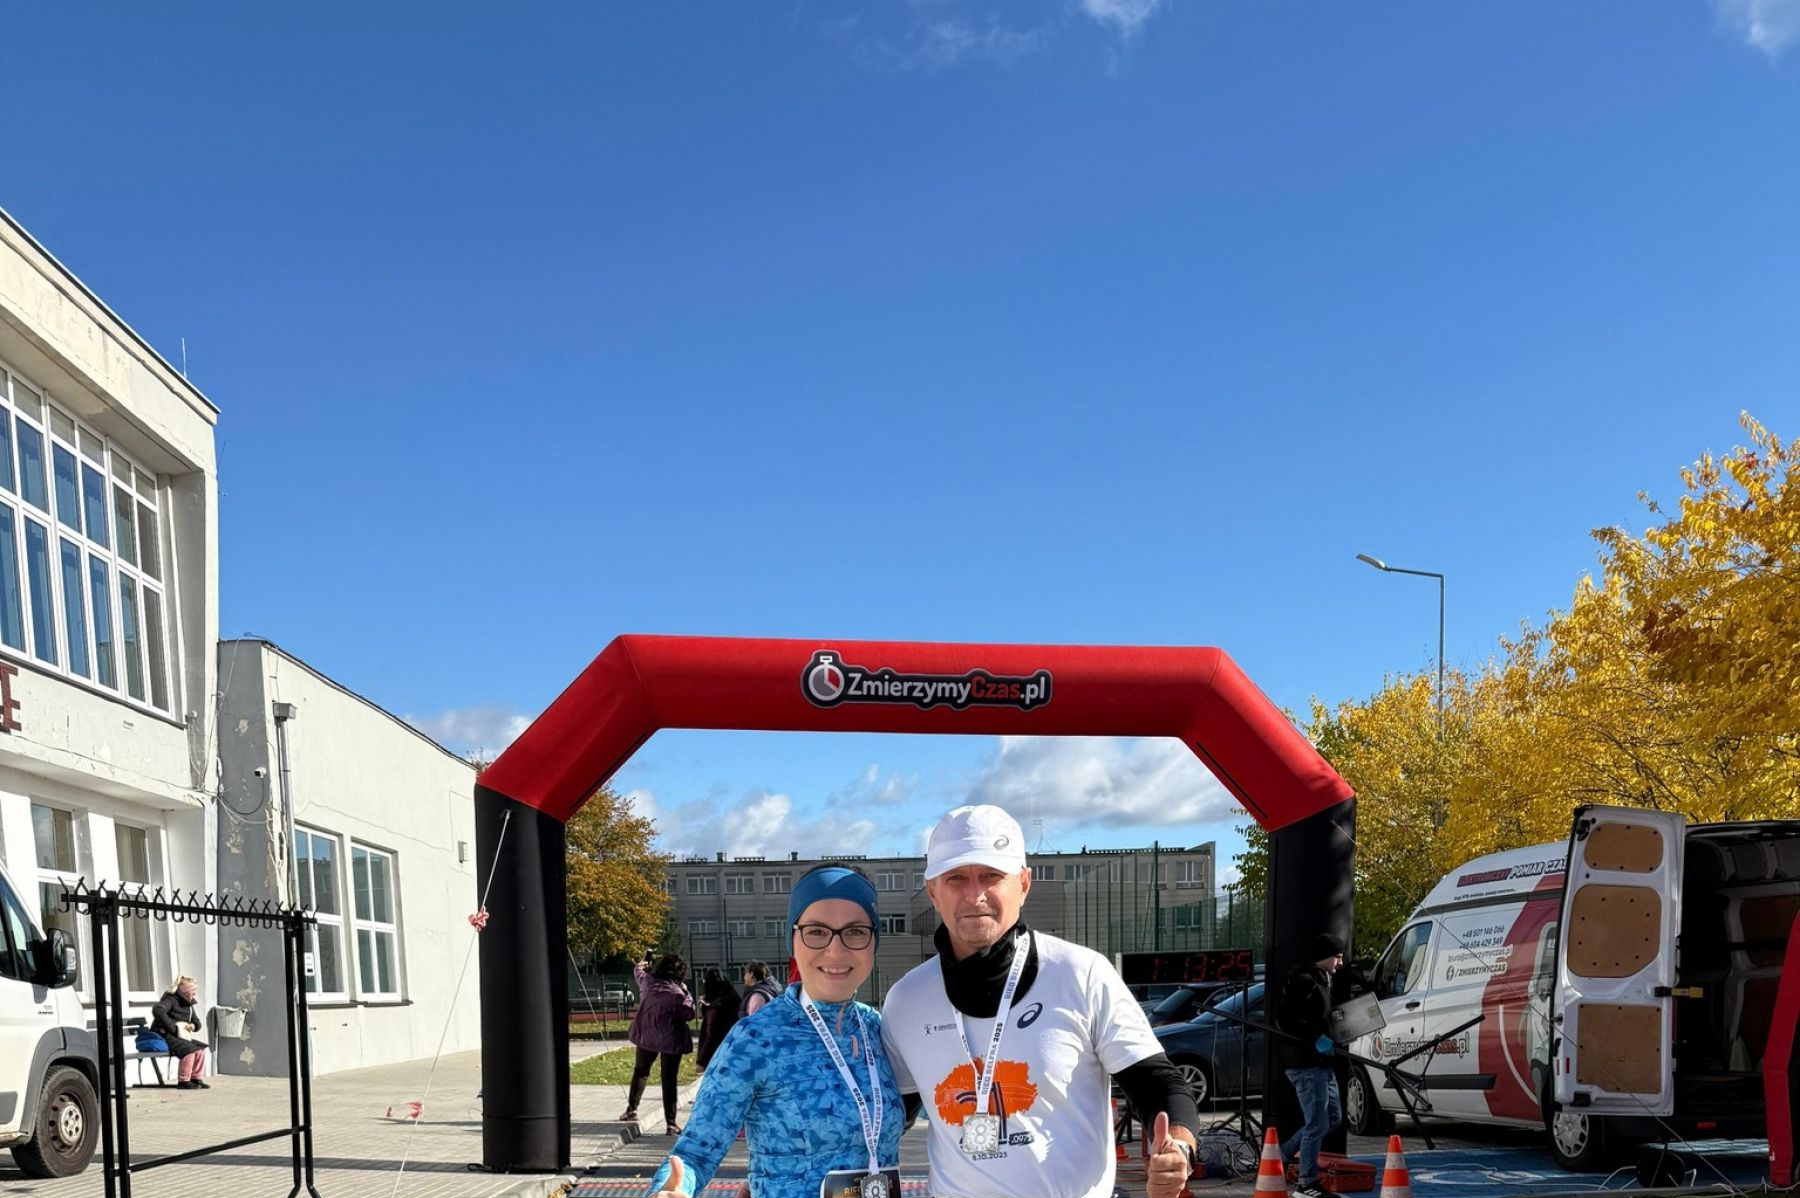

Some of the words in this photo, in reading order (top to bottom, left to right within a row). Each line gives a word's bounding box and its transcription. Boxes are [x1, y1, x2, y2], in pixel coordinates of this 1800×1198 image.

[848, 673, 1045, 704] ZmierzymyCzas.pl
[1510, 861, 1544, 879] POMIAR
[805, 1004, 820, 1022] 2025
[993, 1021, 1002, 1042] 2025
[985, 1043, 997, 1074] BELFRA
[981, 1075, 990, 1095] BIEG
